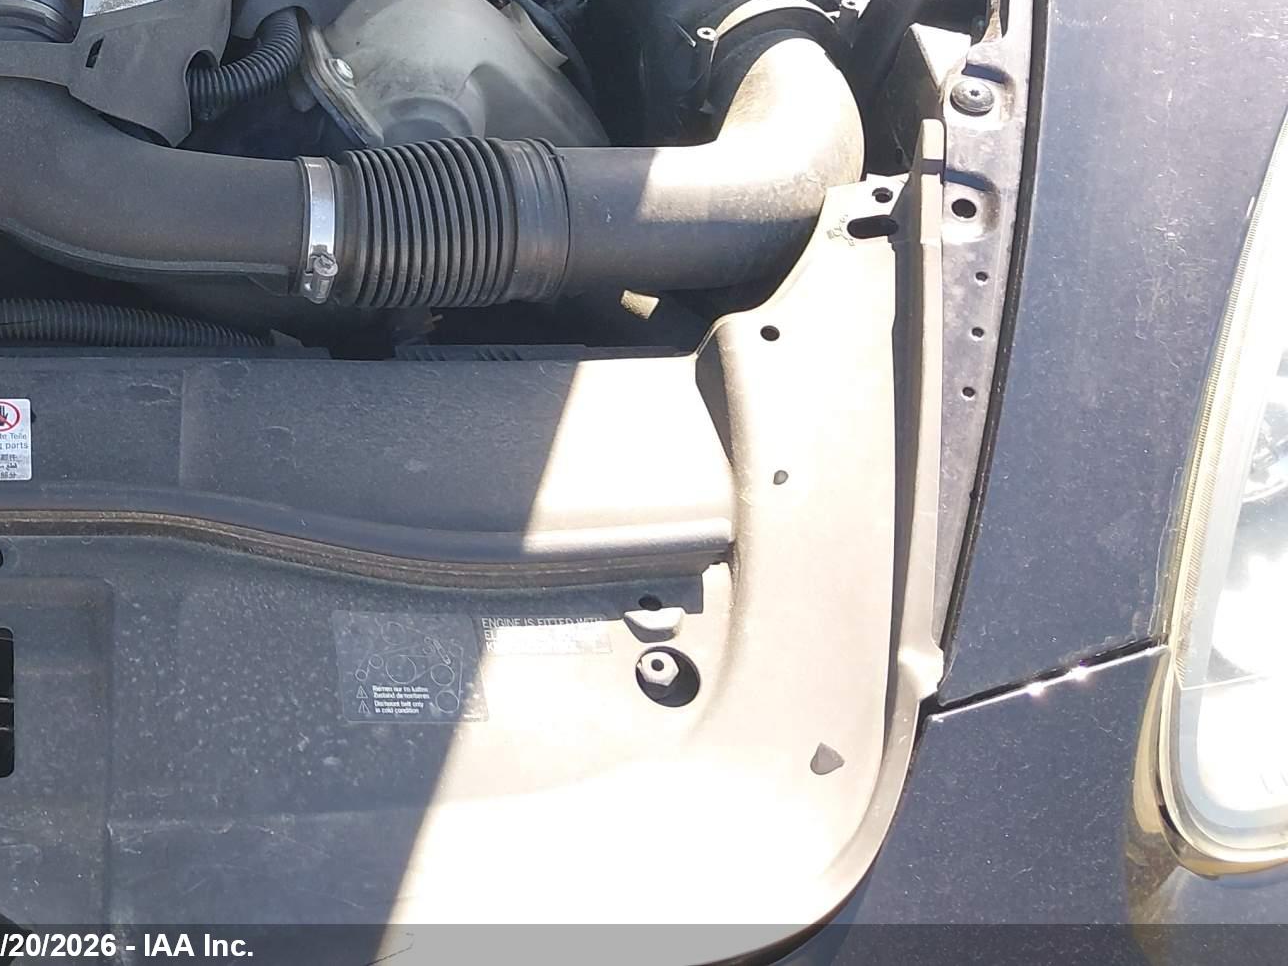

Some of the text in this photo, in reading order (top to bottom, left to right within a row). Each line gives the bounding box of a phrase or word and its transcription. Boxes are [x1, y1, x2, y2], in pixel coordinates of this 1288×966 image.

[6, 442, 29, 450] parts
[482, 618, 520, 628] ENGINE
[524, 618, 536, 627] IS
